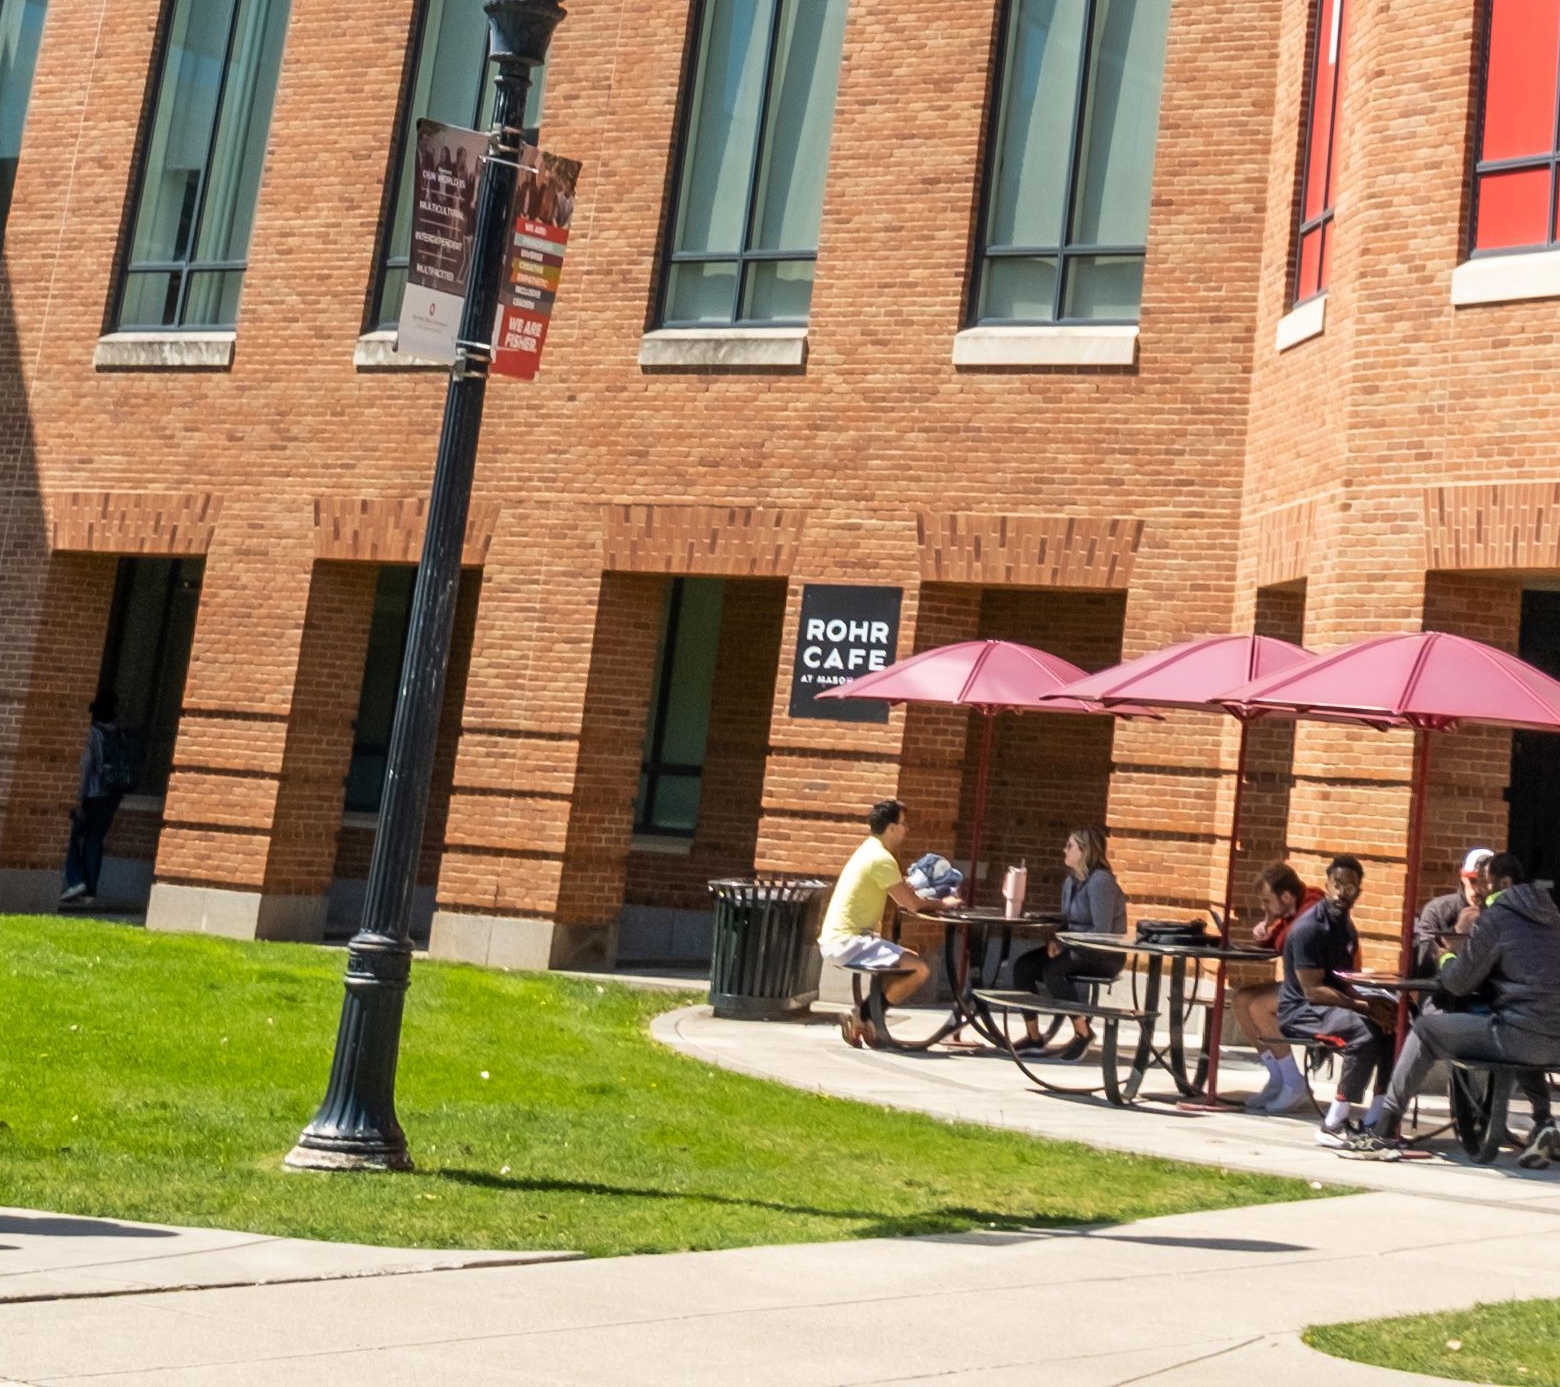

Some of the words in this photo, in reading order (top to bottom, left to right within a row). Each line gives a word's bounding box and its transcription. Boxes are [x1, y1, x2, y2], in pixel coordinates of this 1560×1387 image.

[508, 316, 524, 334] WE
[523, 320, 543, 338] ARE
[806, 618, 890, 644] ROHR
[802, 645, 888, 672] CAFE
[800, 674, 814, 683] AT
